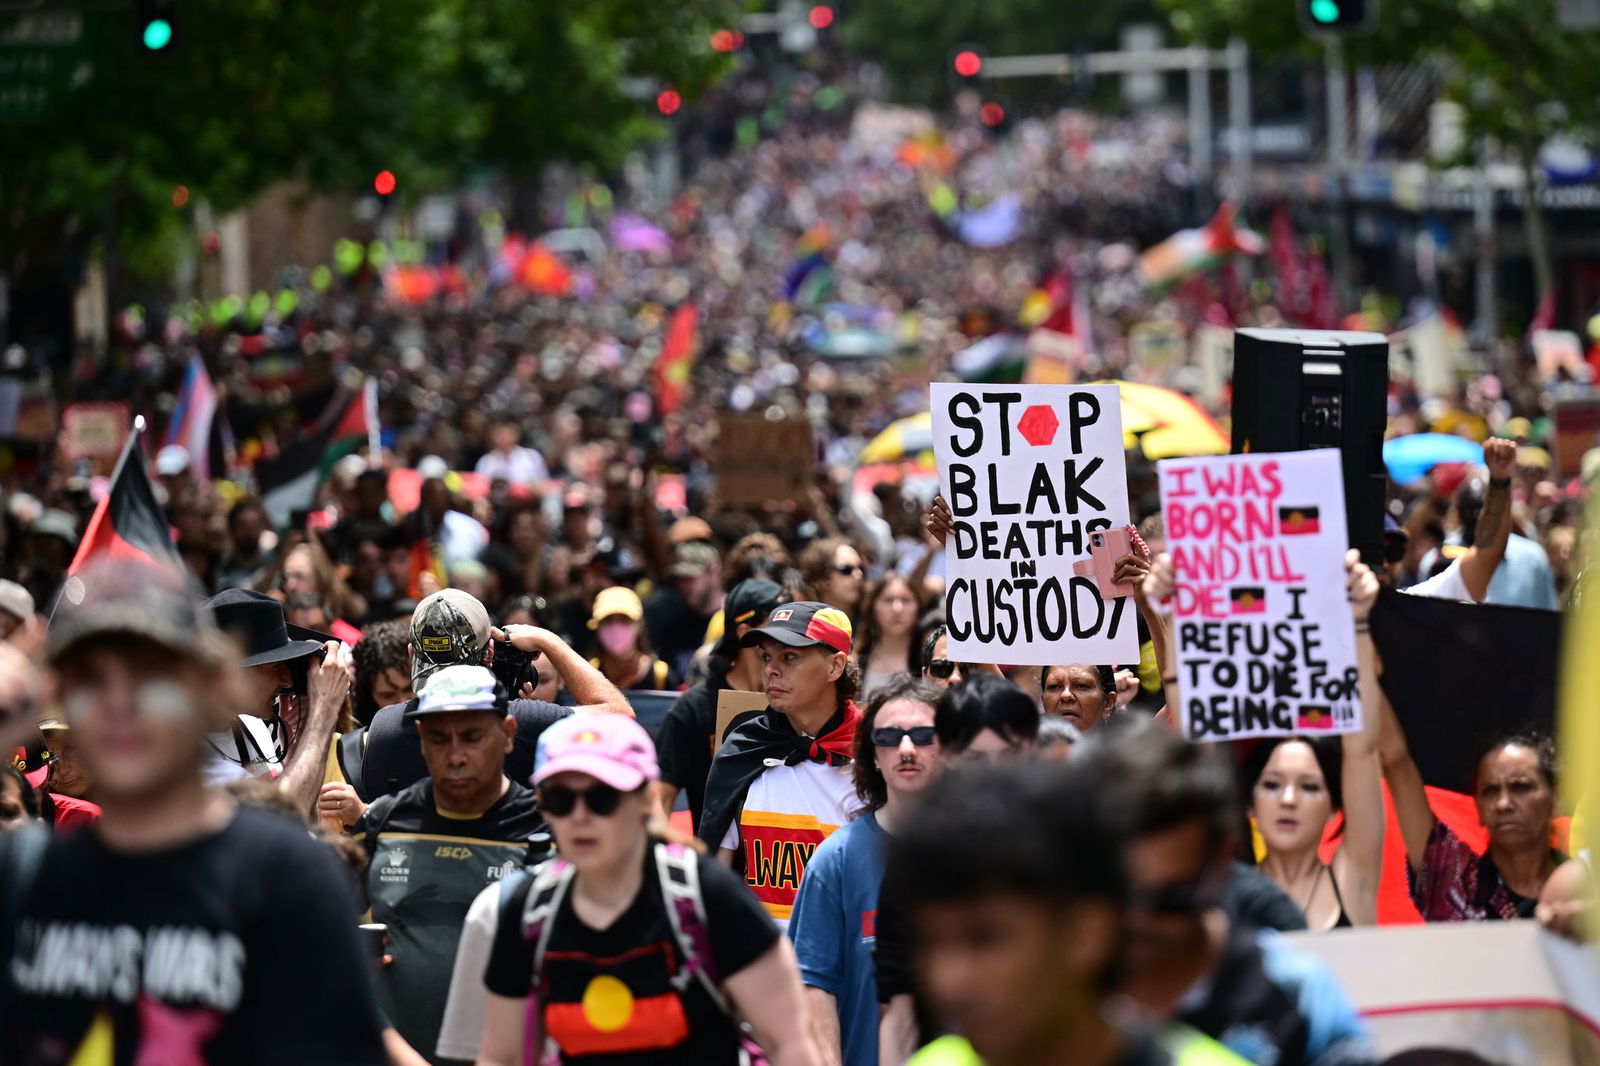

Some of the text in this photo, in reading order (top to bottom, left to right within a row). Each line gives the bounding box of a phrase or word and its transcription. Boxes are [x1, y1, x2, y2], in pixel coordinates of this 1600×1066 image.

[948, 392, 1101, 457] STOP
[949, 457, 1107, 517] BLAK
[1167, 460, 1284, 500] I WAS
[1167, 499, 1275, 544] BORN
[1010, 560, 1037, 578] IN
[1171, 544, 1240, 582] AND
[1174, 583, 1307, 619] DIE I
[1180, 621, 1328, 668] REFUSE
[1184, 659, 1361, 702] TO DIE FOR
[1188, 694, 1294, 738] BEING
[380, 866, 410, 875] CROWN
